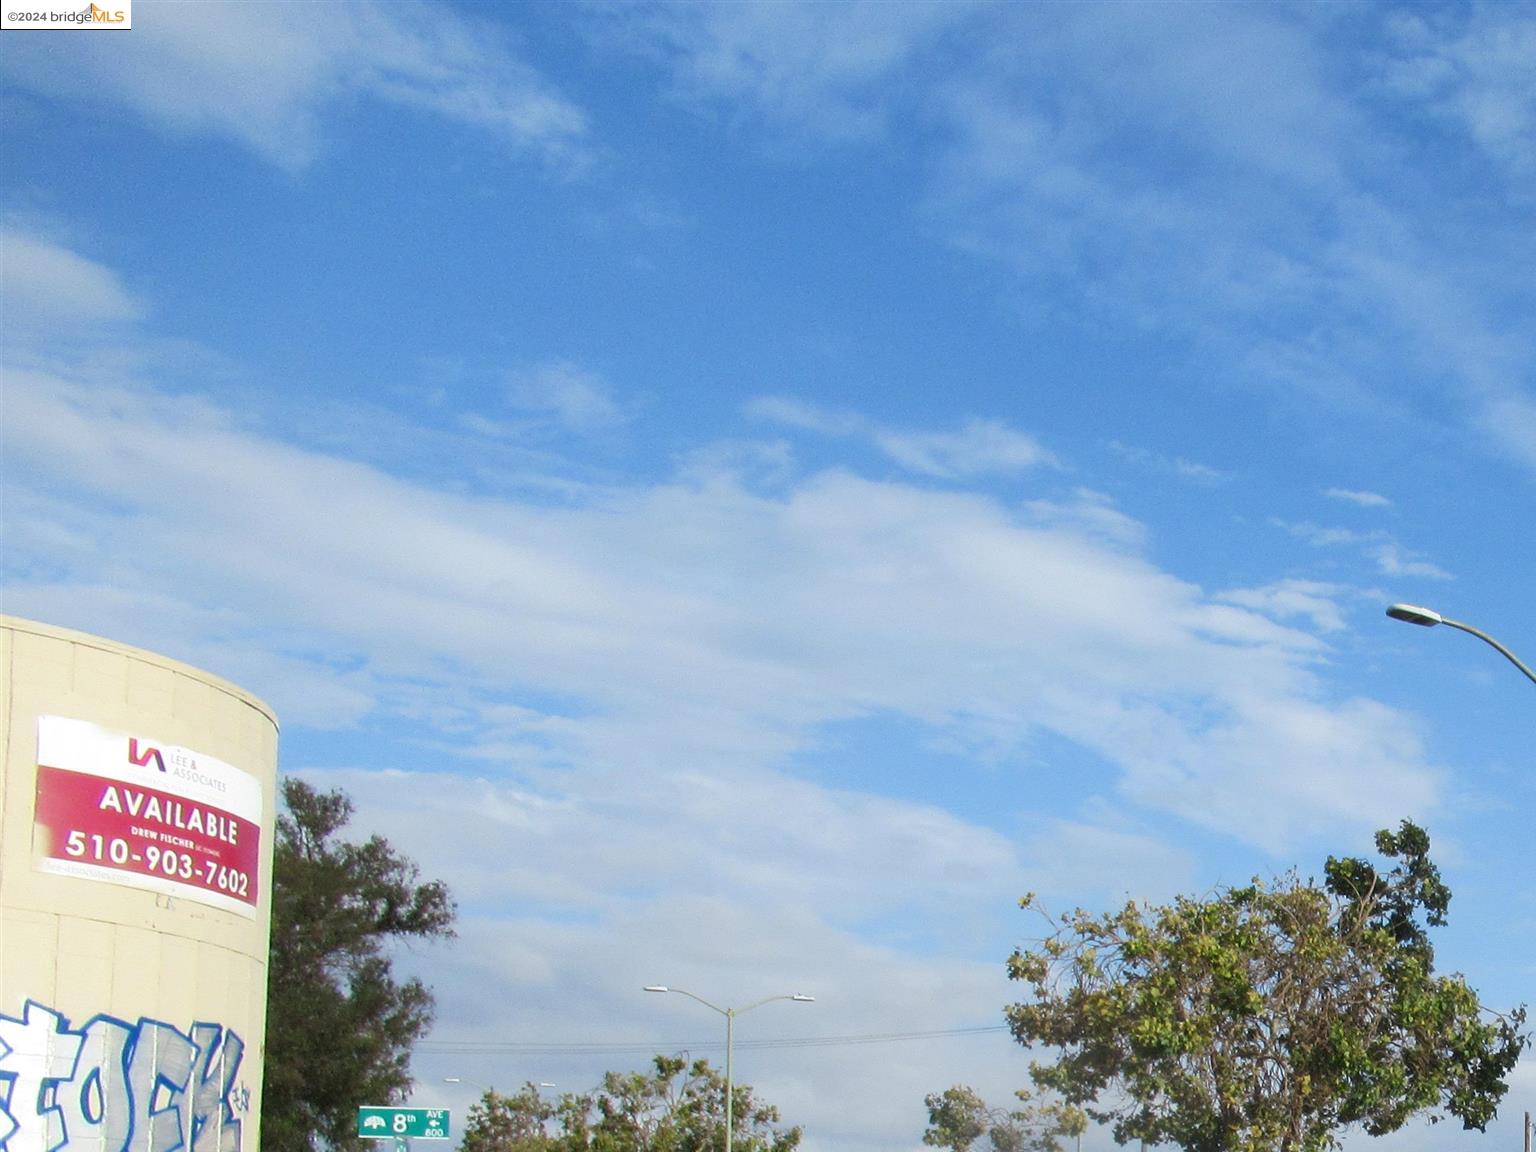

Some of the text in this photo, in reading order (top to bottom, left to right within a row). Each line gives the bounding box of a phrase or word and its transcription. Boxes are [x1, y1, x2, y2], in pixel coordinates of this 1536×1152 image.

[170, 752, 188, 768] LEE
[173, 766, 227, 792] ASSOCIATES
[99, 785, 239, 845] AVAILABLE
[131, 825, 195, 850] DREW FISCHER
[65, 830, 248, 897] 510-903-7602
[393, 1113, 417, 1133] 8th
[426, 1110, 444, 1119] AVE
